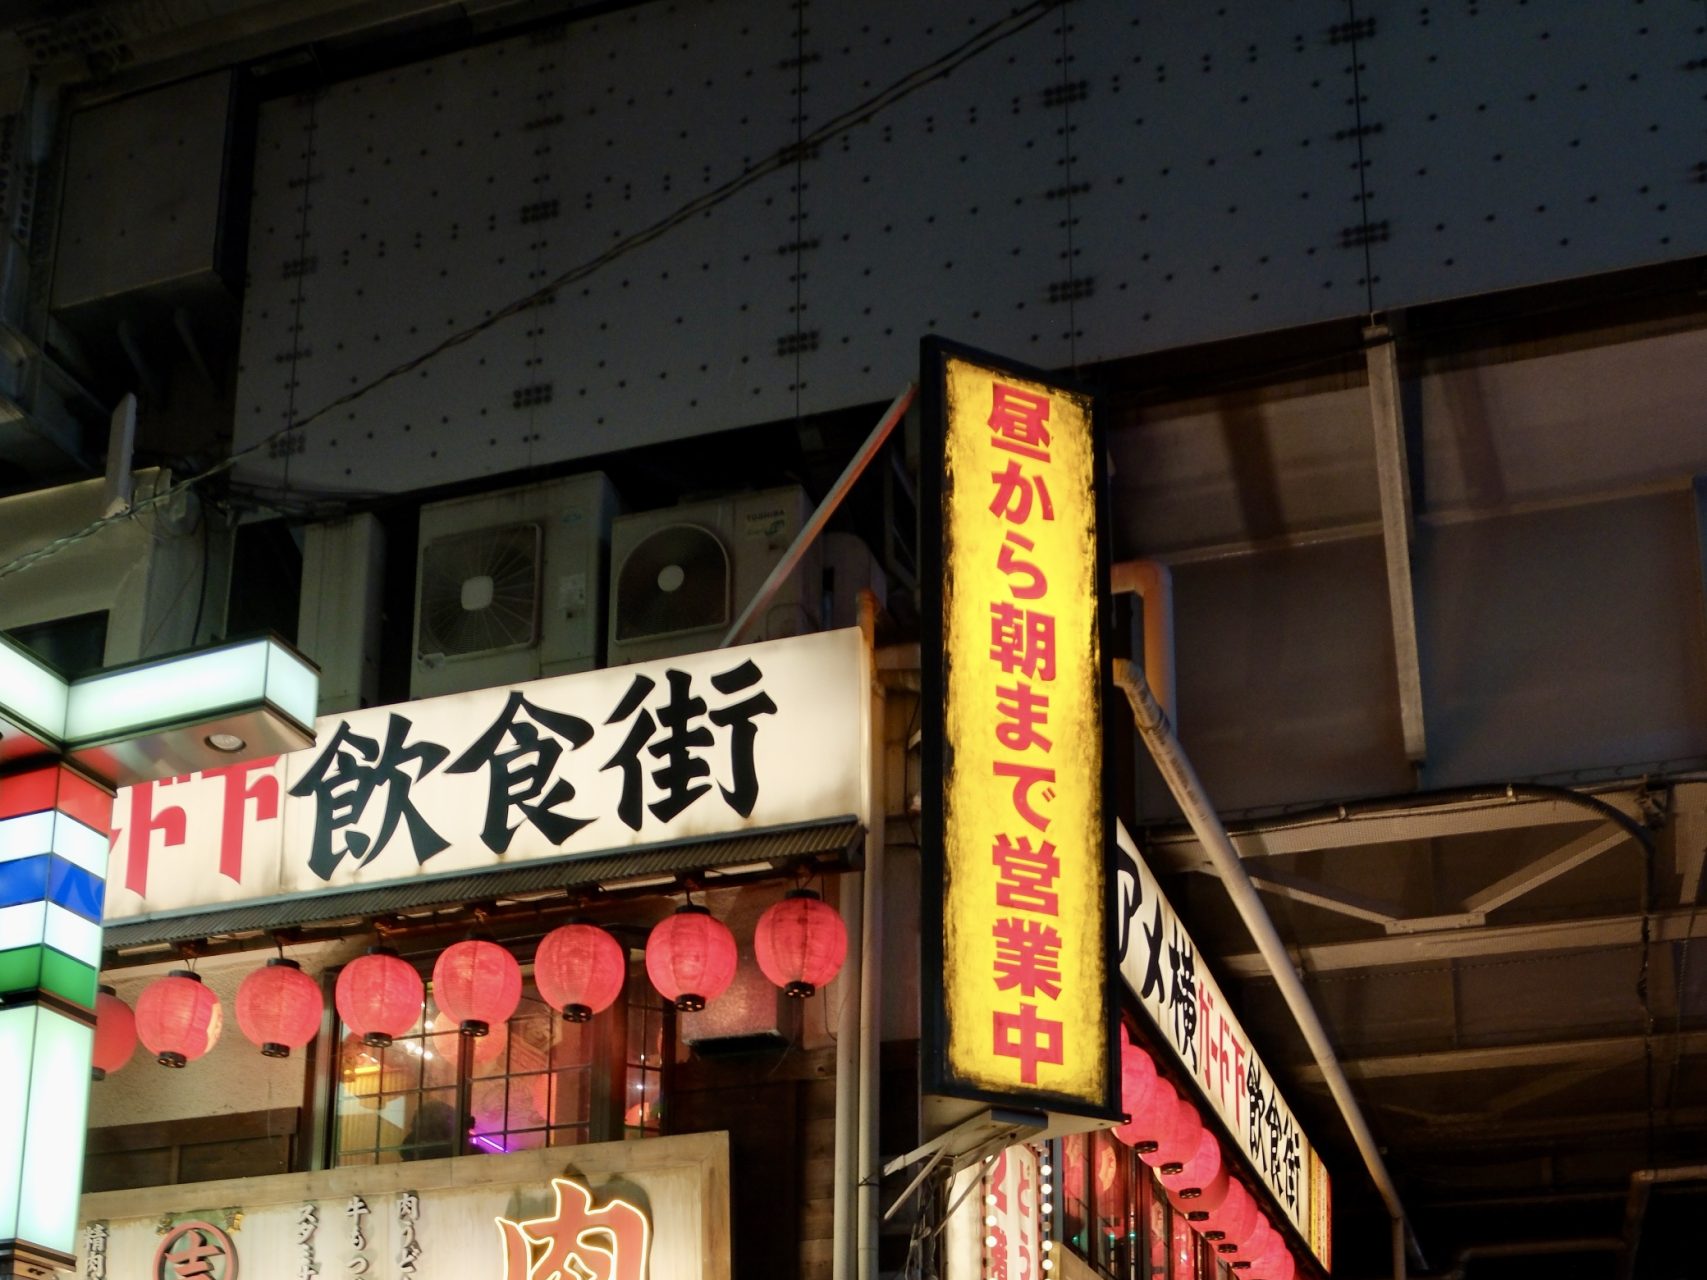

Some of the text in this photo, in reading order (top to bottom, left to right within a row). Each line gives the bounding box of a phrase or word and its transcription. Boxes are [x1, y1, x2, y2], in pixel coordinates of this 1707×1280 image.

[987, 381, 1064, 1085] 昼から朝まで営業中
